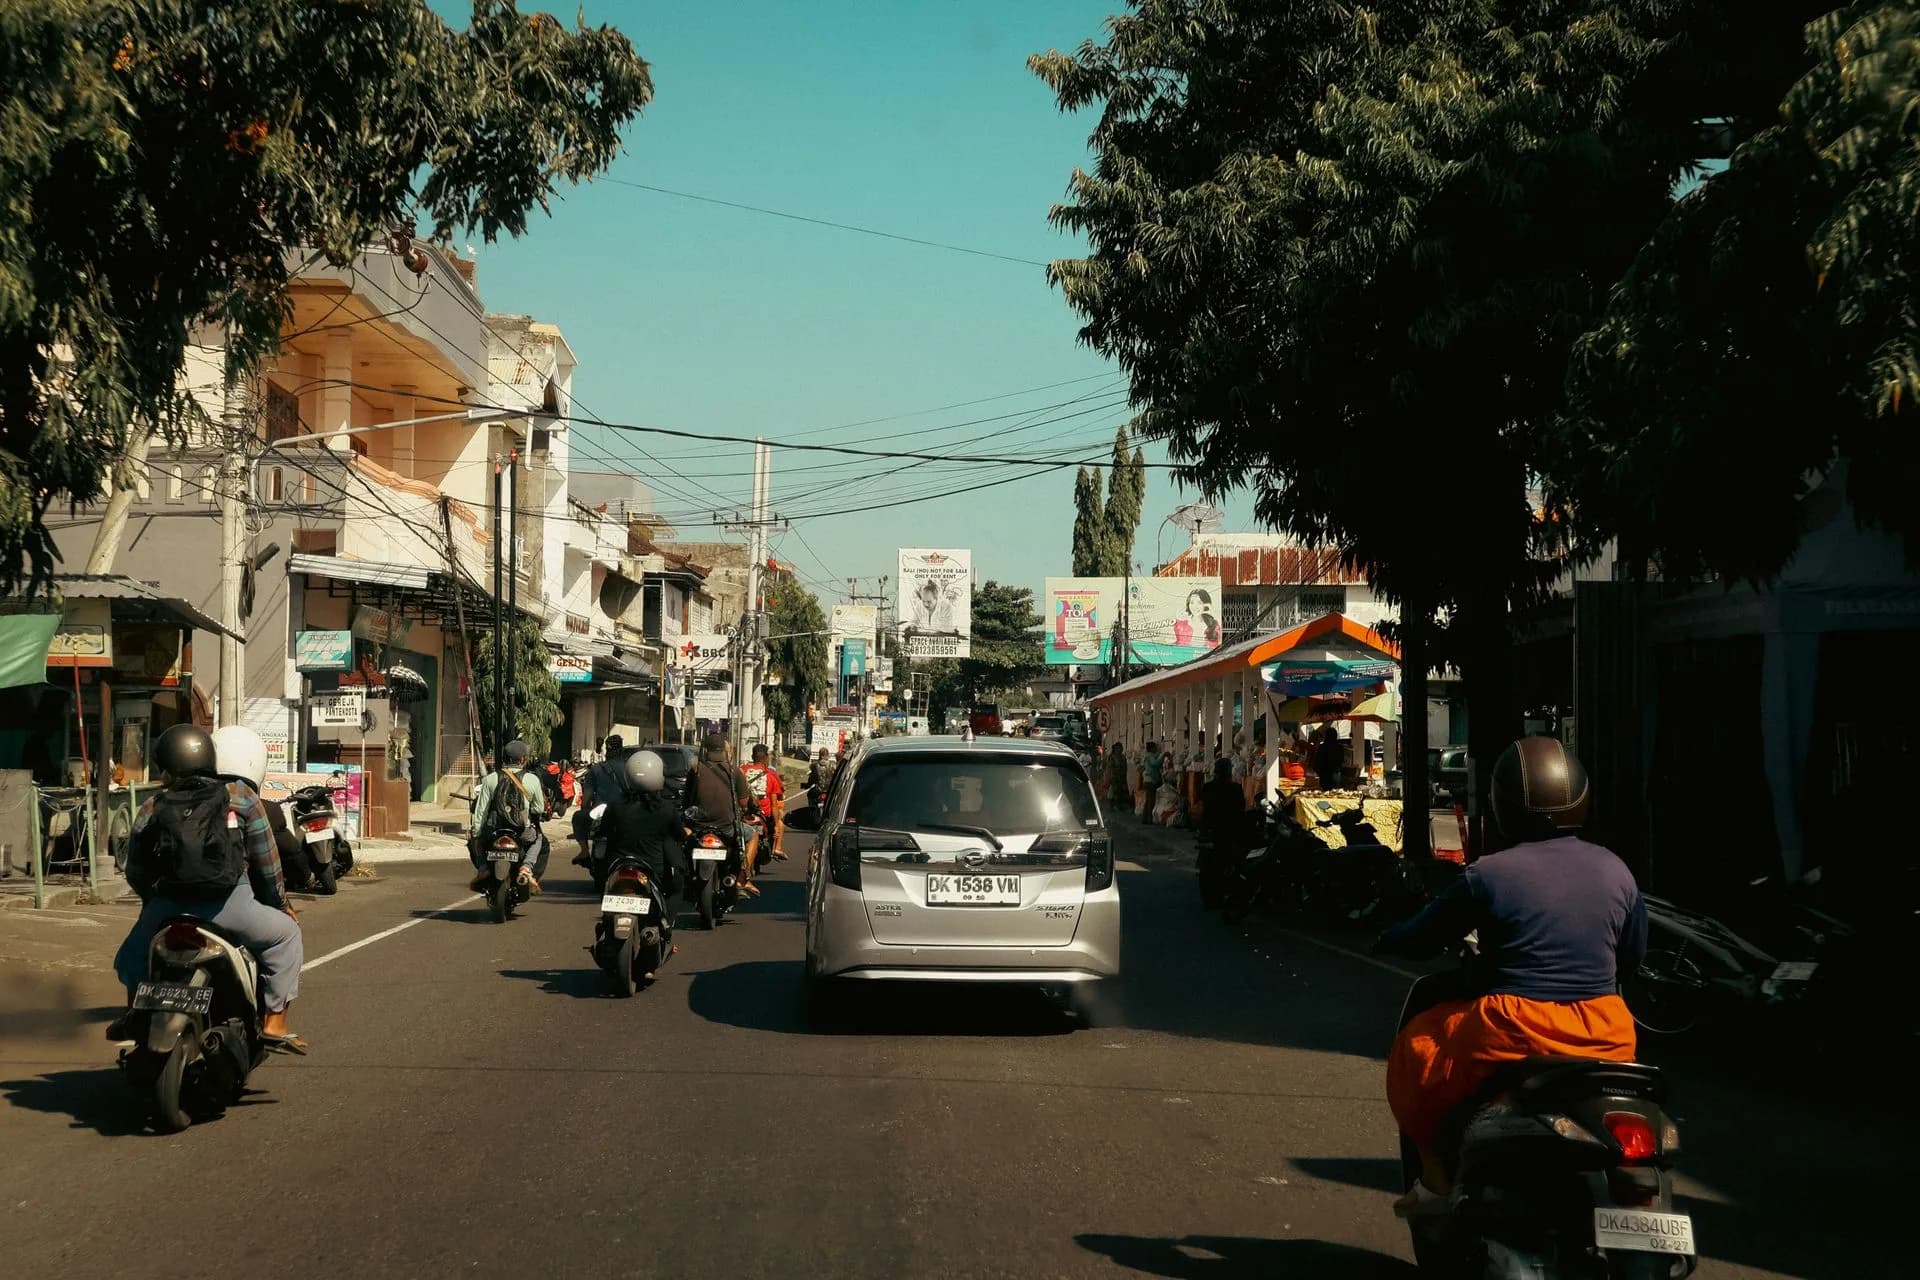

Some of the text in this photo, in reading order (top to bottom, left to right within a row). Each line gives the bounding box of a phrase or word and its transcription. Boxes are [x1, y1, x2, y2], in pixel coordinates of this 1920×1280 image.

[910, 637, 927, 646] SPACE
[702, 648, 725, 658] BBC
[328, 698, 355, 706] GEREJA
[325, 707, 357, 716] PANTEKOSTA
[929, 876, 951, 892] DK
[138, 984, 155, 997] DK
[1601, 1086, 1638, 1096] HONDA
